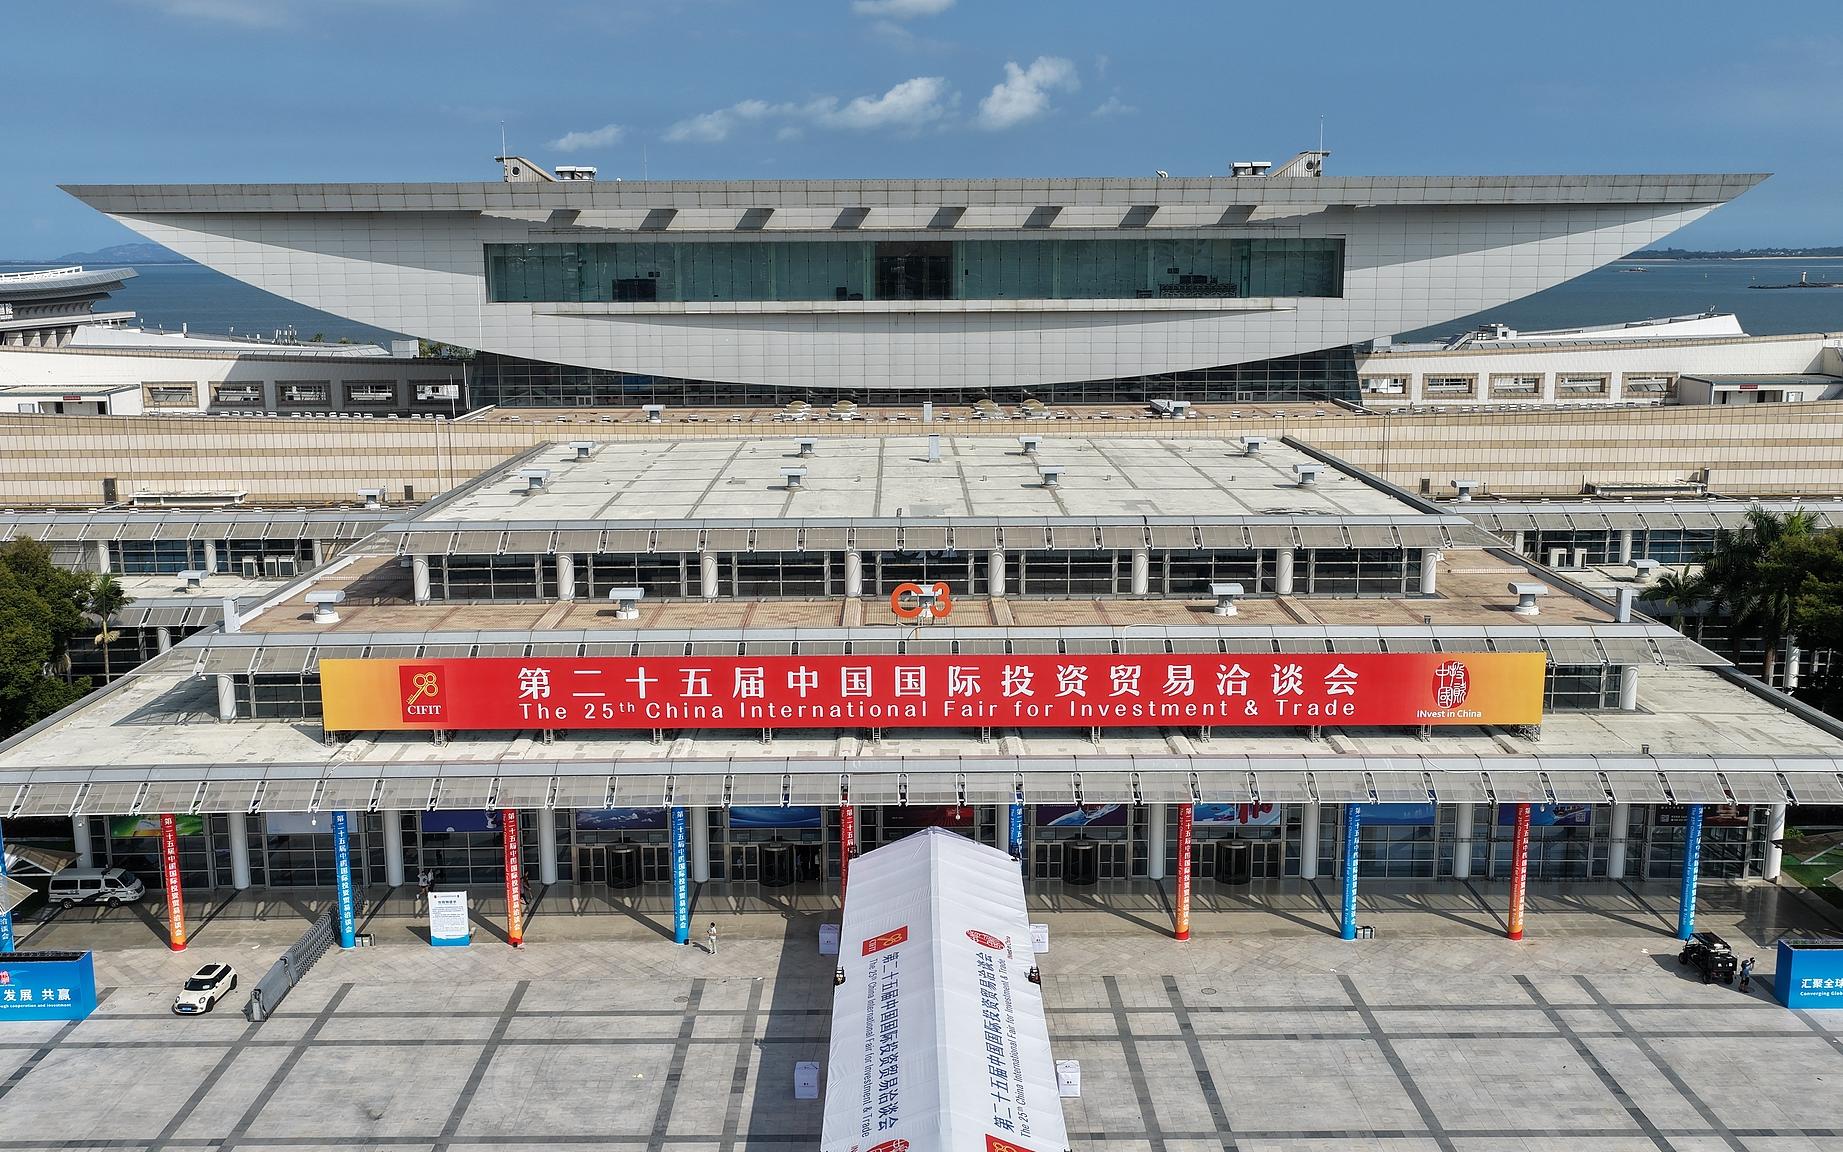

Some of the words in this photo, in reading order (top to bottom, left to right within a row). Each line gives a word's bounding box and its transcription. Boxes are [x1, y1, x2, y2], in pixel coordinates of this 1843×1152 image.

[891, 582, 951, 618] C3
[518, 664, 1358, 700] 第二十五届中国国际投资贸易洽谈会
[407, 705, 442, 715] CIFIT
[519, 703, 567, 719] The
[584, 702, 635, 719] 25th
[646, 702, 724, 719] China
[740, 700, 926, 718] International
[944, 700, 997, 717] Fair
[1014, 700, 1053, 717] for
[1071, 699, 1227, 717] Investment
[1244, 700, 1259, 716] &
[1277, 700, 1355, 716] Trade
[1417, 709, 1445, 718] INvest
[1447, 709, 1455, 718] in
[1457, 709, 1482, 718] China
[868, 959, 878, 969] The
[997, 959, 1007, 974] Trade
[4, 989, 32, 1001] 发展
[42, 988, 71, 1001] 共赢
[867, 982, 876, 998] China
[1001, 982, 1013, 1013] Investment
[865, 999, 876, 1037] International
[1004, 1015, 1015, 1024] for
[1006, 1026, 1017, 1038] Fair
[864, 1039, 874, 1052] Fair
[878, 952, 899, 1132] 第二十五届中国国际投资贸易洽谈会
[976, 953, 1015, 1133] 第二十五届中国国际投资贸易洽谈会
[864, 1053, 873, 1062] for
[1008, 1040, 1023, 1082] International
[862, 1066, 873, 1106] Investment
[1014, 1085, 1026, 1105] China
[1017, 1107, 1028, 1122] 25th
[861, 1114, 872, 1137] Trade
[1020, 1124, 1031, 1138] The
